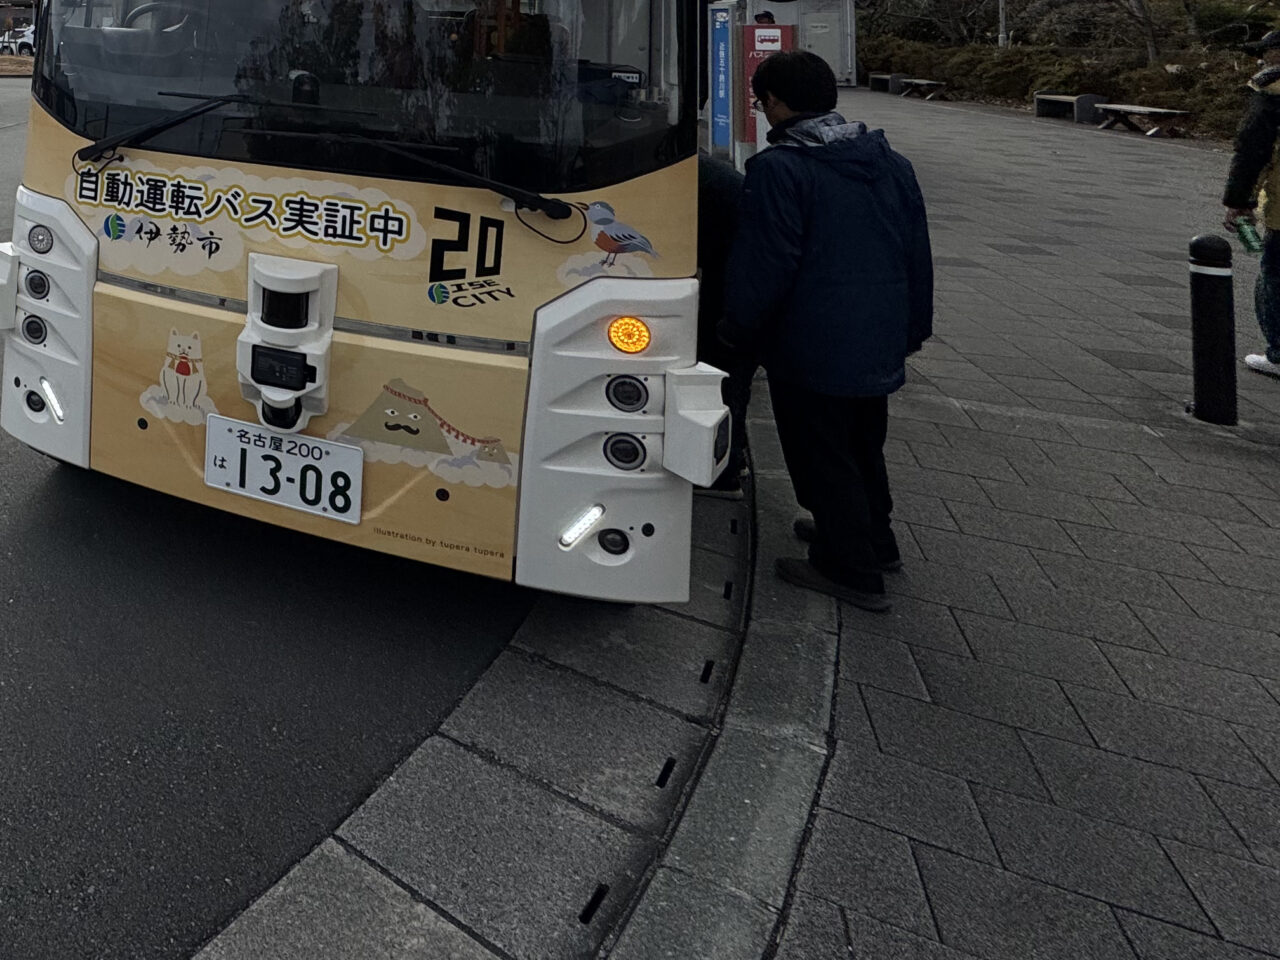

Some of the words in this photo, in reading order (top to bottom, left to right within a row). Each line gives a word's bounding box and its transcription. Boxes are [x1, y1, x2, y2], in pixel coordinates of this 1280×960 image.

[78, 168, 404, 246] 自動運転バス実証中
[135, 221, 223, 259] 伊勢市
[429, 206, 504, 283] 20
[450, 279, 500, 293] ISE
[452, 287, 516, 308] CITY
[213, 454, 227, 470] は
[239, 447, 352, 514] 13-08
[425, 537, 437, 548] by
[439, 540, 471, 553] tupera
[474, 546, 506, 559] tupera
